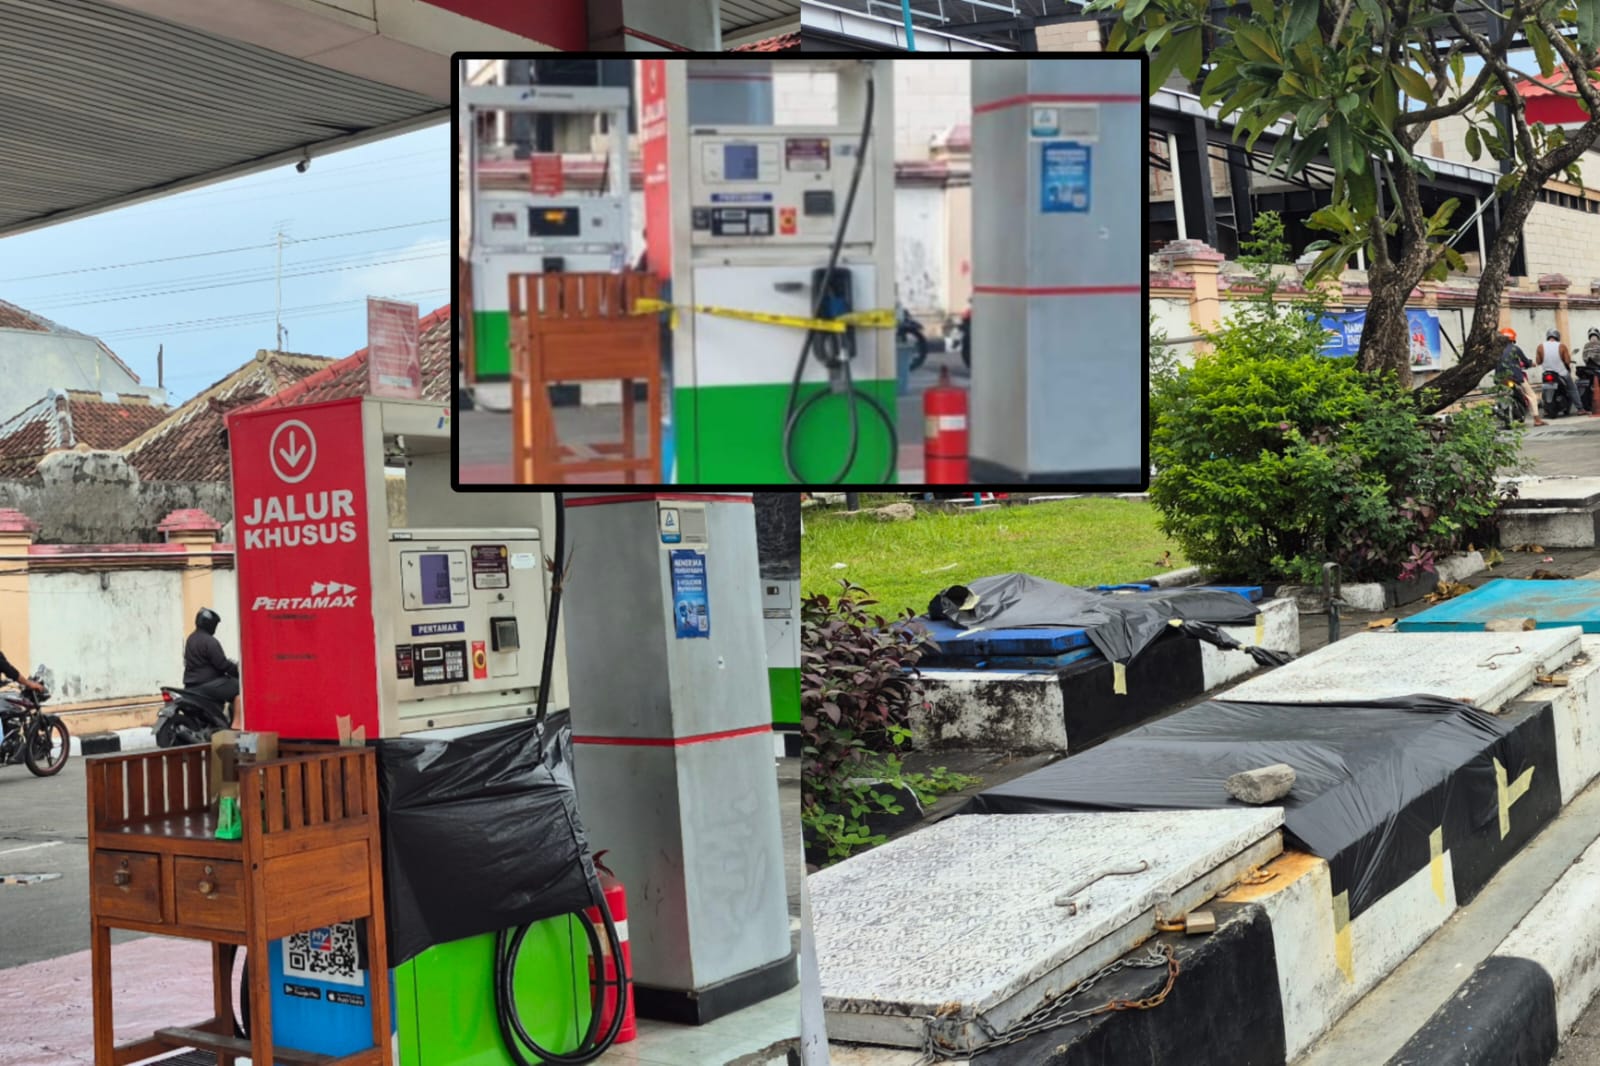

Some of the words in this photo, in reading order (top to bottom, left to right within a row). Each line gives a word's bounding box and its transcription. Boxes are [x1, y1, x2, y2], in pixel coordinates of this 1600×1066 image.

[243, 489, 356, 525] JALUR
[244, 521, 357, 550] KHUSUS
[251, 595, 357, 610] PERTAMAX
[418, 623, 458, 634] PERTAMAX
